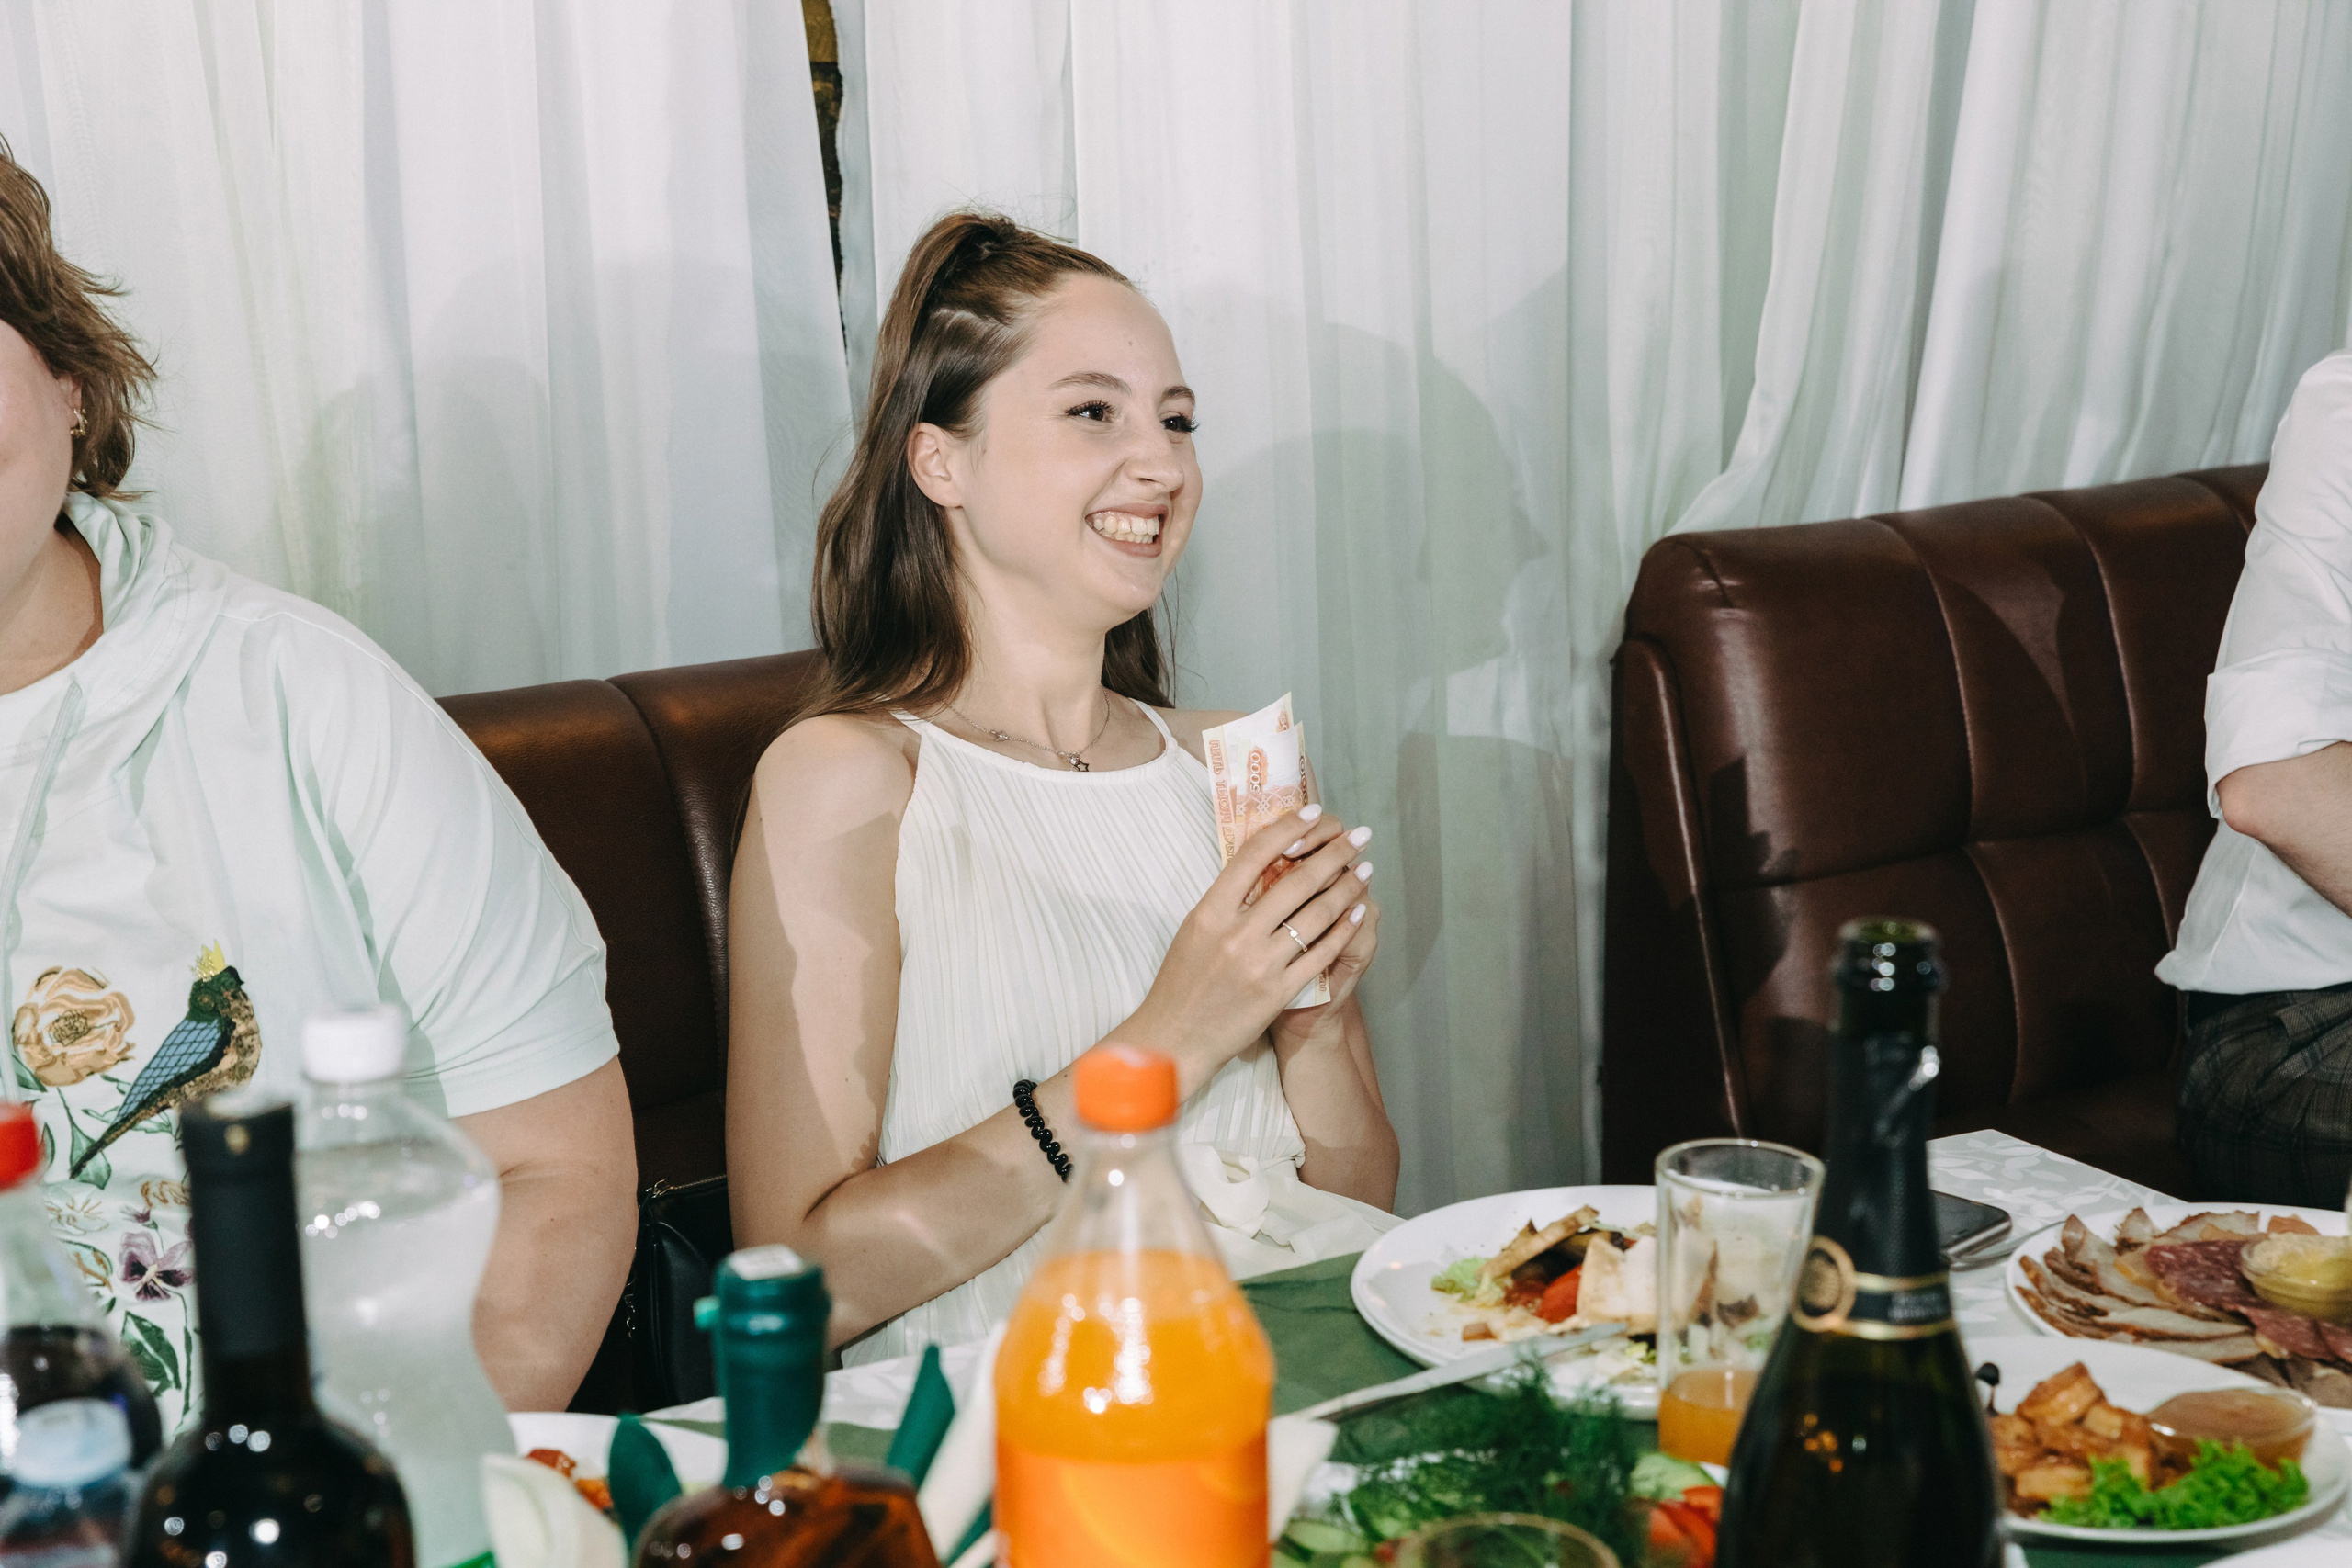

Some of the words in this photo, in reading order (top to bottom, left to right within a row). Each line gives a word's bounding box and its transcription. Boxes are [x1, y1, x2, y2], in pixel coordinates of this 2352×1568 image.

[1209, 740, 1224, 775] ПЯТЬ
[1250, 752, 1261, 794] 5000
[1216, 779, 1232, 824] ТЫСЯЧ
